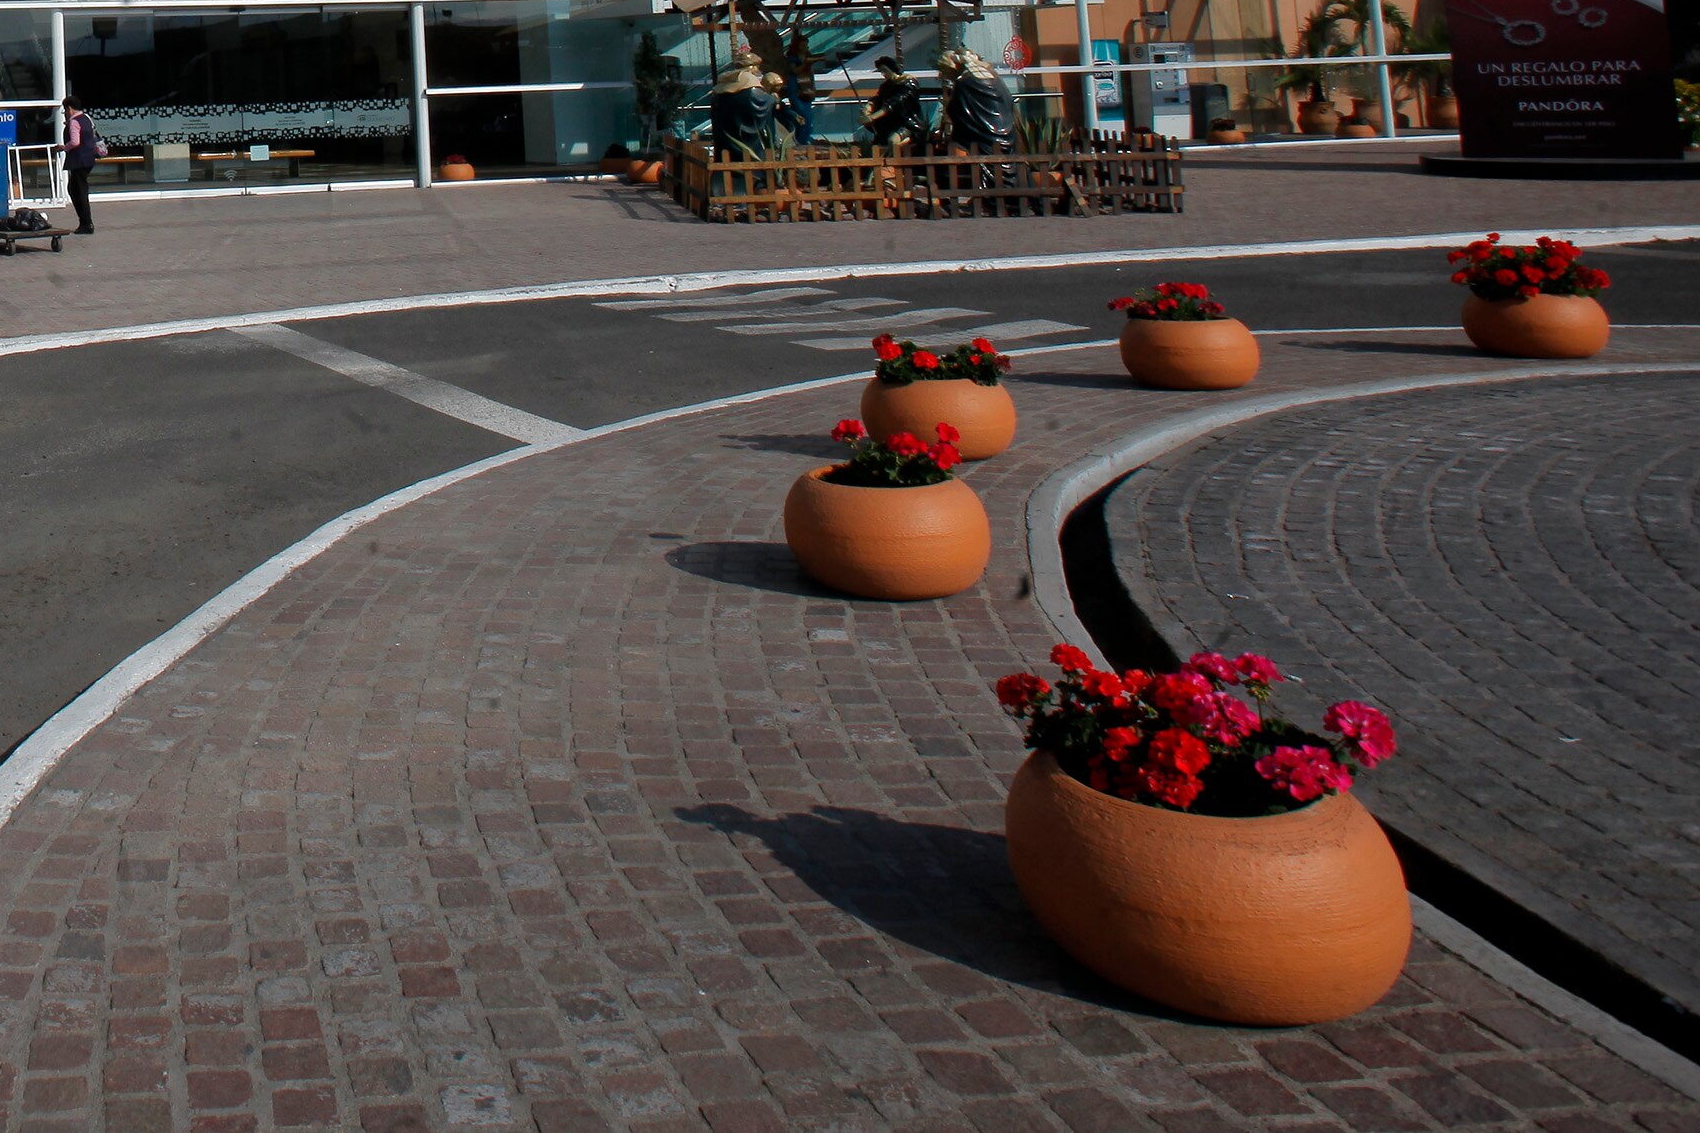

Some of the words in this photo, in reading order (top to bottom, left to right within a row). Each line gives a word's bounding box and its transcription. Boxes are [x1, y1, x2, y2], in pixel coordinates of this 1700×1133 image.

[1477, 63, 1504, 74] UN
[1511, 61, 1586, 73] REGALO
[1592, 60, 1642, 71] PARA
[1498, 74, 1622, 86] DESLUMBRAR
